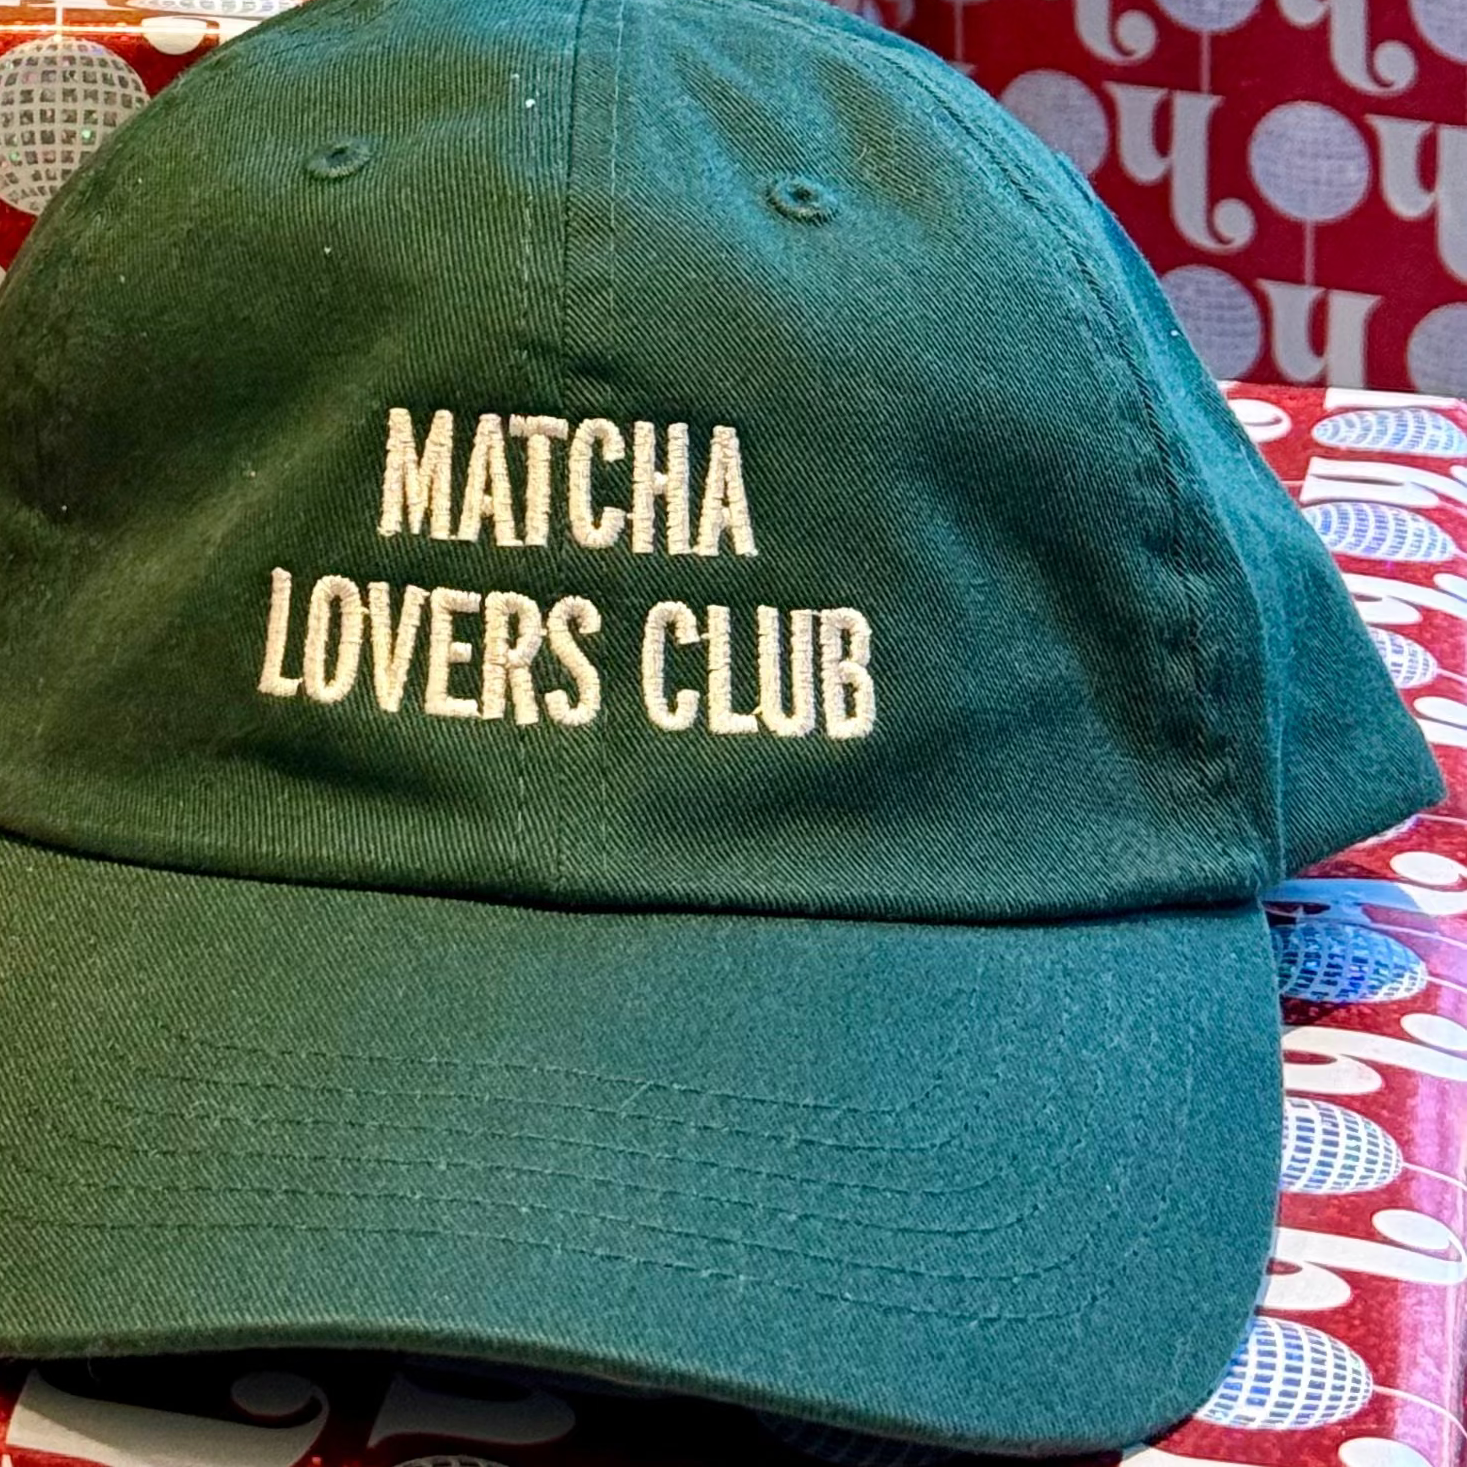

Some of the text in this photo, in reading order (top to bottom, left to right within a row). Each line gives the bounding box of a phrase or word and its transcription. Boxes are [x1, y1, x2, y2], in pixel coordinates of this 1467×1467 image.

[378, 406, 759, 558] MATCHA
[257, 565, 877, 740] LOVERS CLUB
